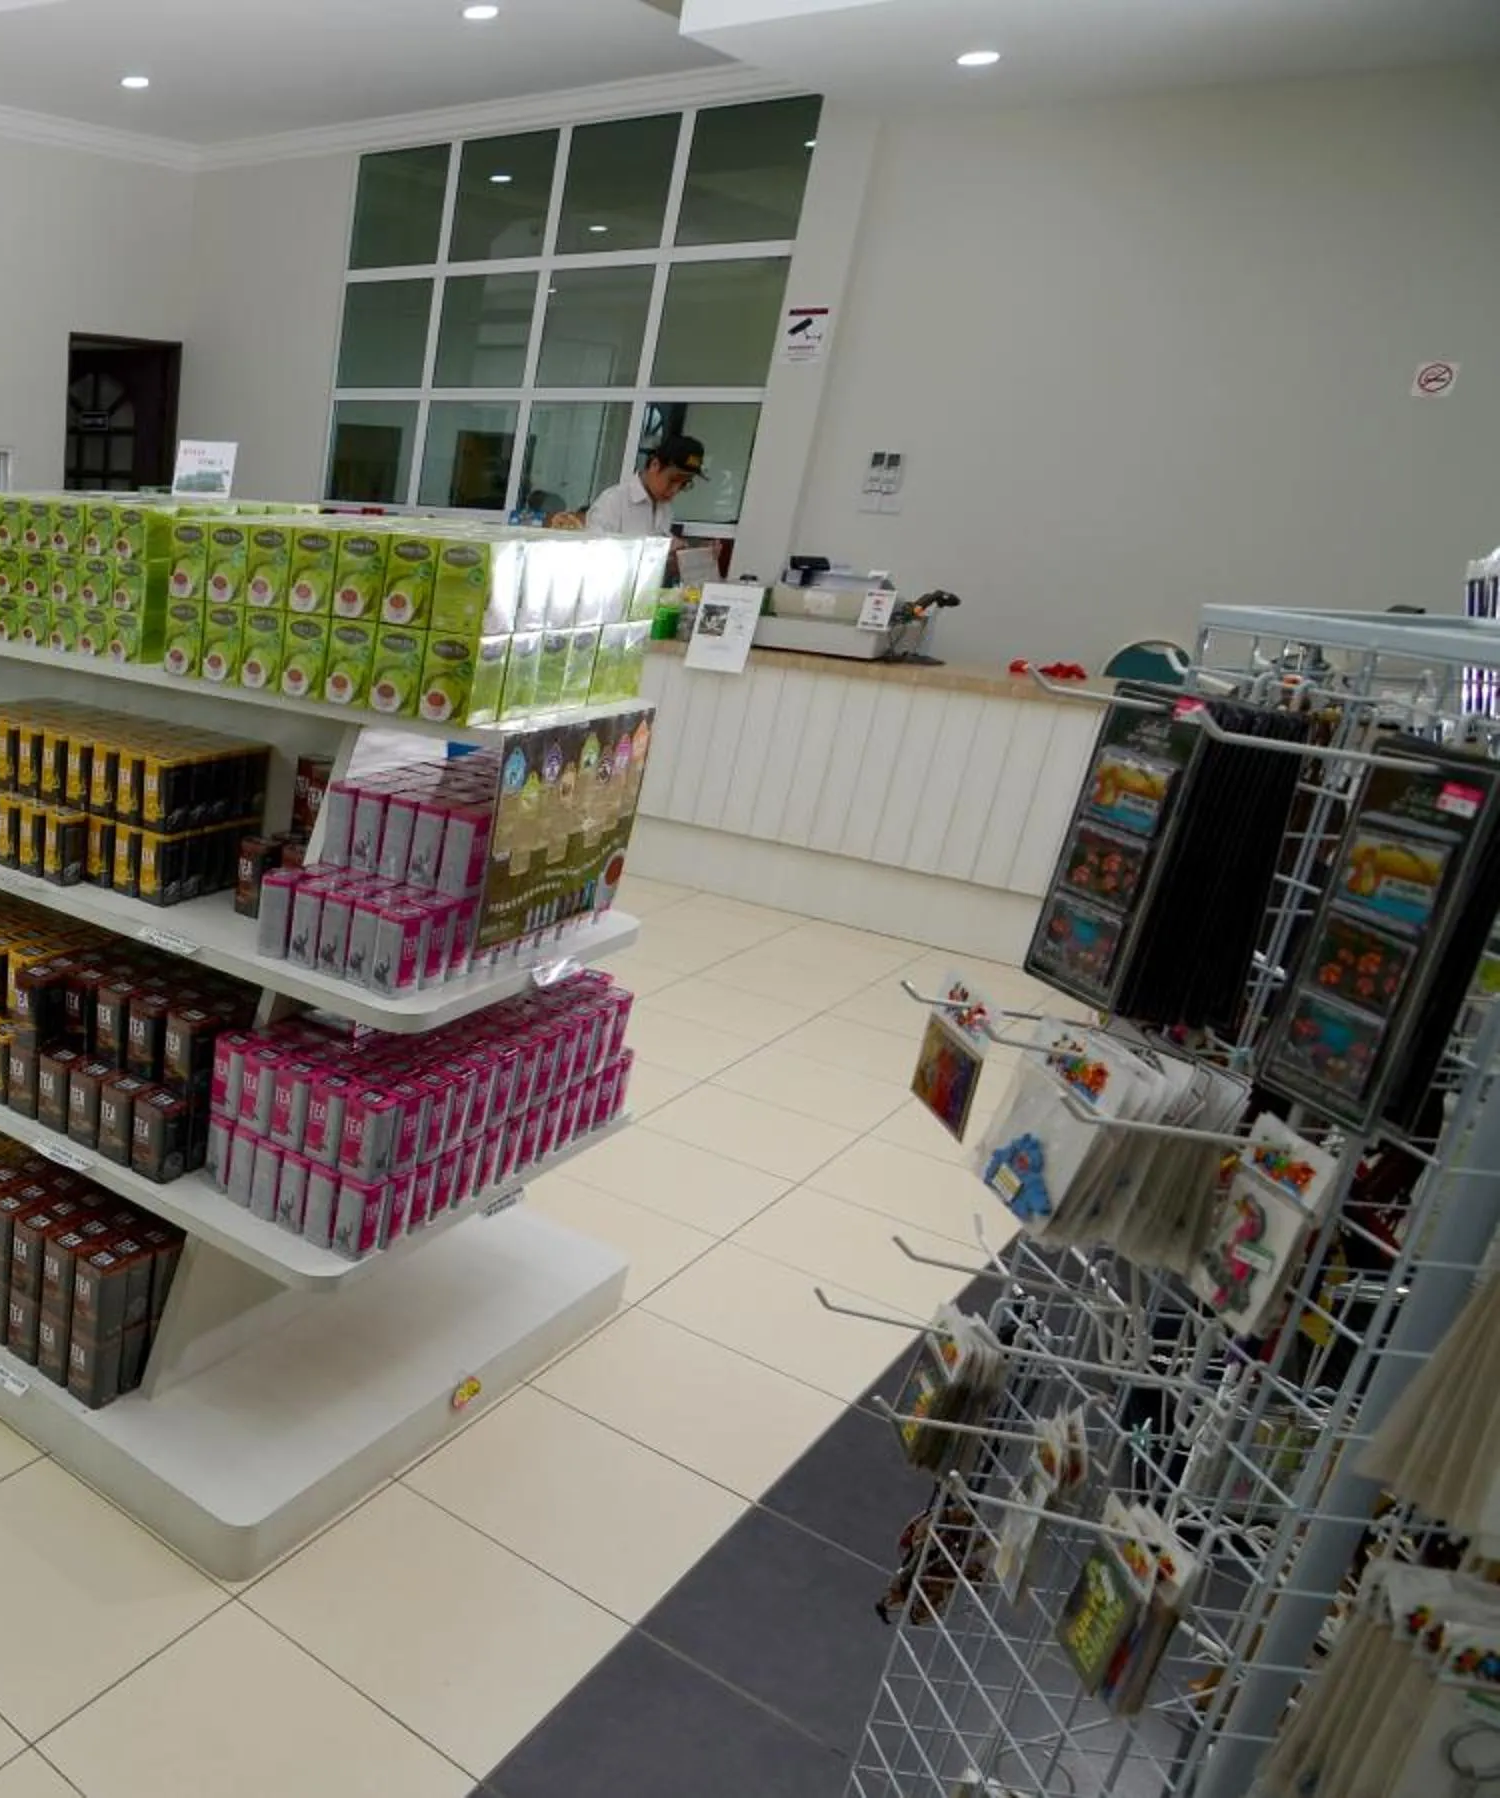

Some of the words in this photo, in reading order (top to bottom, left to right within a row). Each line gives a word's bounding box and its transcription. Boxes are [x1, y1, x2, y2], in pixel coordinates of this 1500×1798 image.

[97, 1004, 111, 1025] TEA
[130, 1016, 145, 1037] TEA
[166, 1032, 180, 1051] TEA
[40, 1071, 54, 1090] TEA
[244, 1072, 257, 1089] TEA
[71, 1087, 84, 1106] TEA
[276, 1087, 290, 1104] TEA
[102, 1101, 115, 1121] TEA
[310, 1101, 325, 1118] TEA
[134, 1117, 148, 1137] TEA
[345, 1118, 363, 1135] TEA
[13, 1236, 27, 1256] TEA
[44, 1255, 58, 1276] TEA
[76, 1275, 90, 1295] TEA
[10, 1303, 23, 1323] TEA
[40, 1322, 54, 1343] TEA
[71, 1343, 85, 1364] TEA
